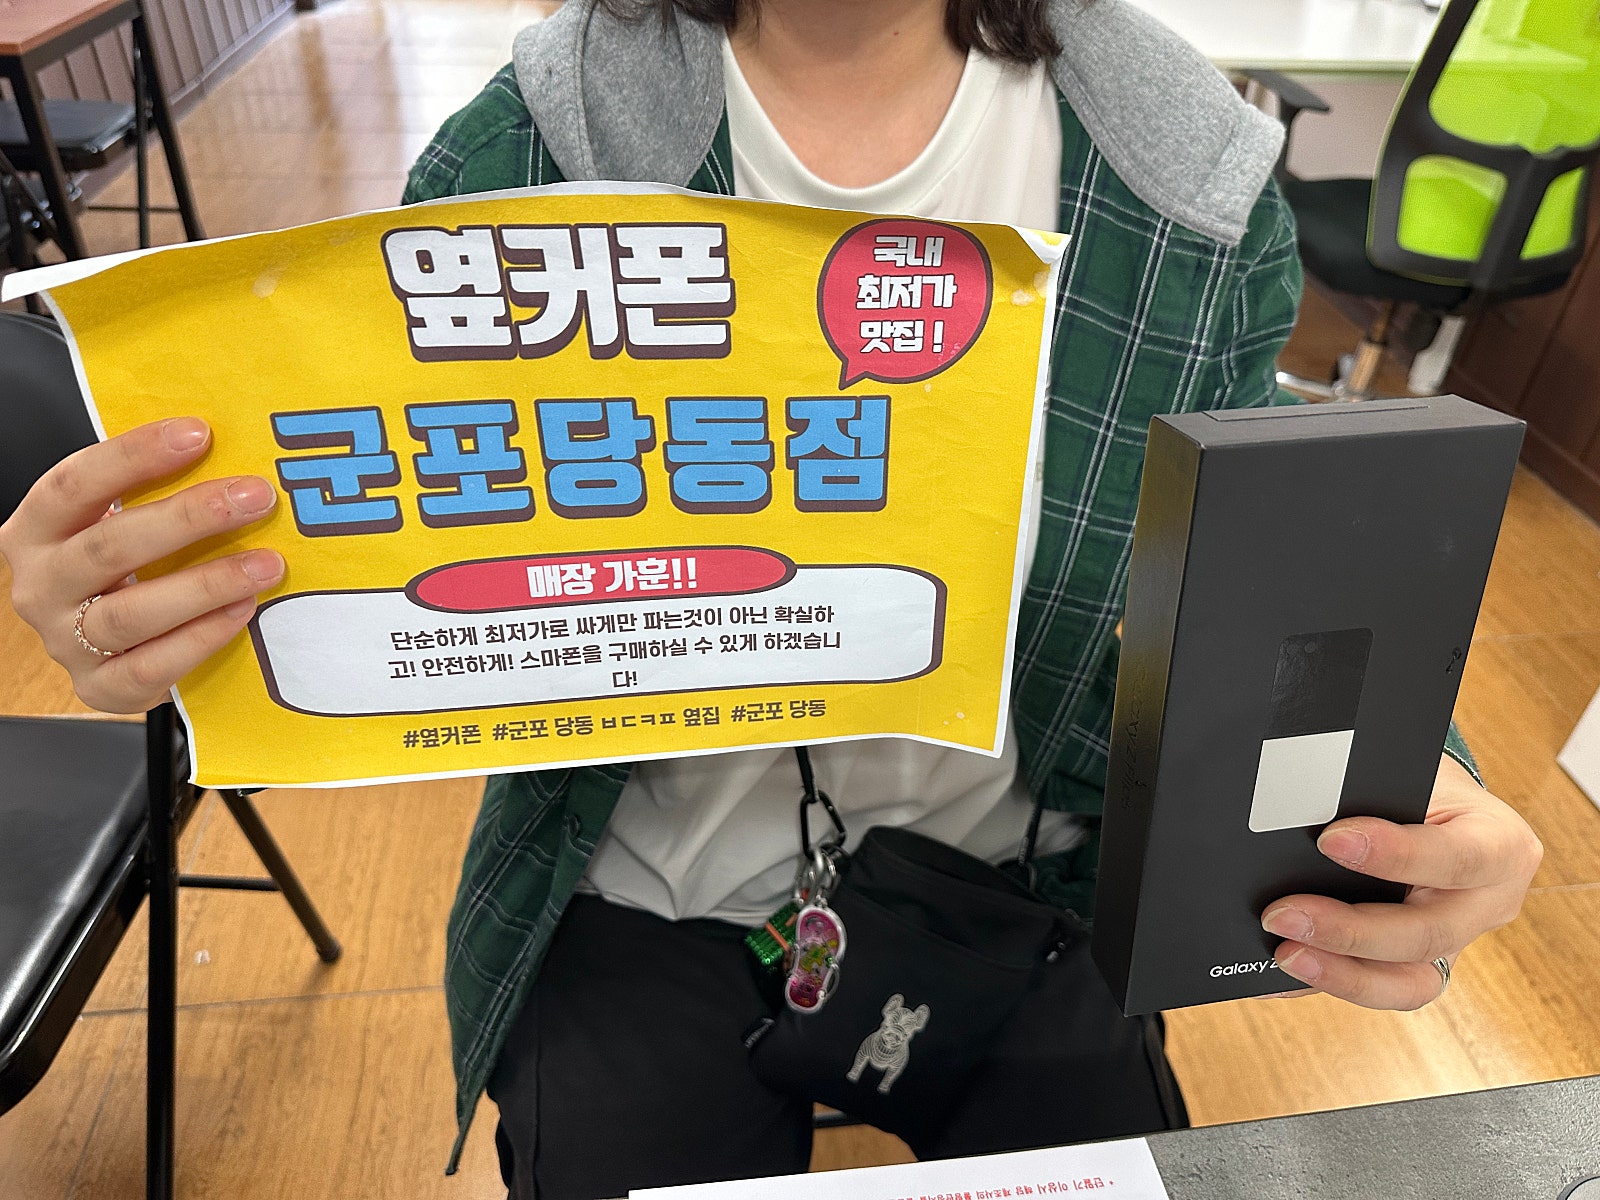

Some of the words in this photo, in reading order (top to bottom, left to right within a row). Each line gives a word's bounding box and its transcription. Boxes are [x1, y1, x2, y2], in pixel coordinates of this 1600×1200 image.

[873, 235, 945, 268] 국내
[383, 223, 734, 360] 옆커폰
[856, 273, 958, 309] 최저가
[270, 396, 891, 537] 군포당동점
[526, 562, 597, 598] 매장
[602, 557, 698, 592] 가훈!!
[390, 626, 478, 650] 단순하게
[485, 619, 570, 644] 최저가로
[576, 612, 637, 635] 싸게만
[643, 608, 722, 630] 파는것이
[729, 606, 767, 624] 아닌
[774, 605, 834, 624] 확실하
[388, 660, 416, 679] 고!
[421, 653, 513, 677] 안전하게!
[520, 644, 602, 670] 스마폰을
[608, 637, 687, 662] 구매하실
[694, 636, 713, 655] 수
[719, 633, 757, 653] 있게
[763, 632, 841, 650] 하겠습니
[612, 670, 637, 688] 다!
[403, 724, 482, 749] #옆커폰
[492, 719, 549, 741] #군포
[554, 715, 594, 737] 당동
[683, 706, 720, 727] 옆집
[731, 701, 783, 723] #군포
[789, 699, 826, 719] 당동
[1209, 960, 1269, 978] Galaxy
[1036, 1181, 1068, 1195] 이상시
[1072, 1177, 1104, 1191] 단말기
